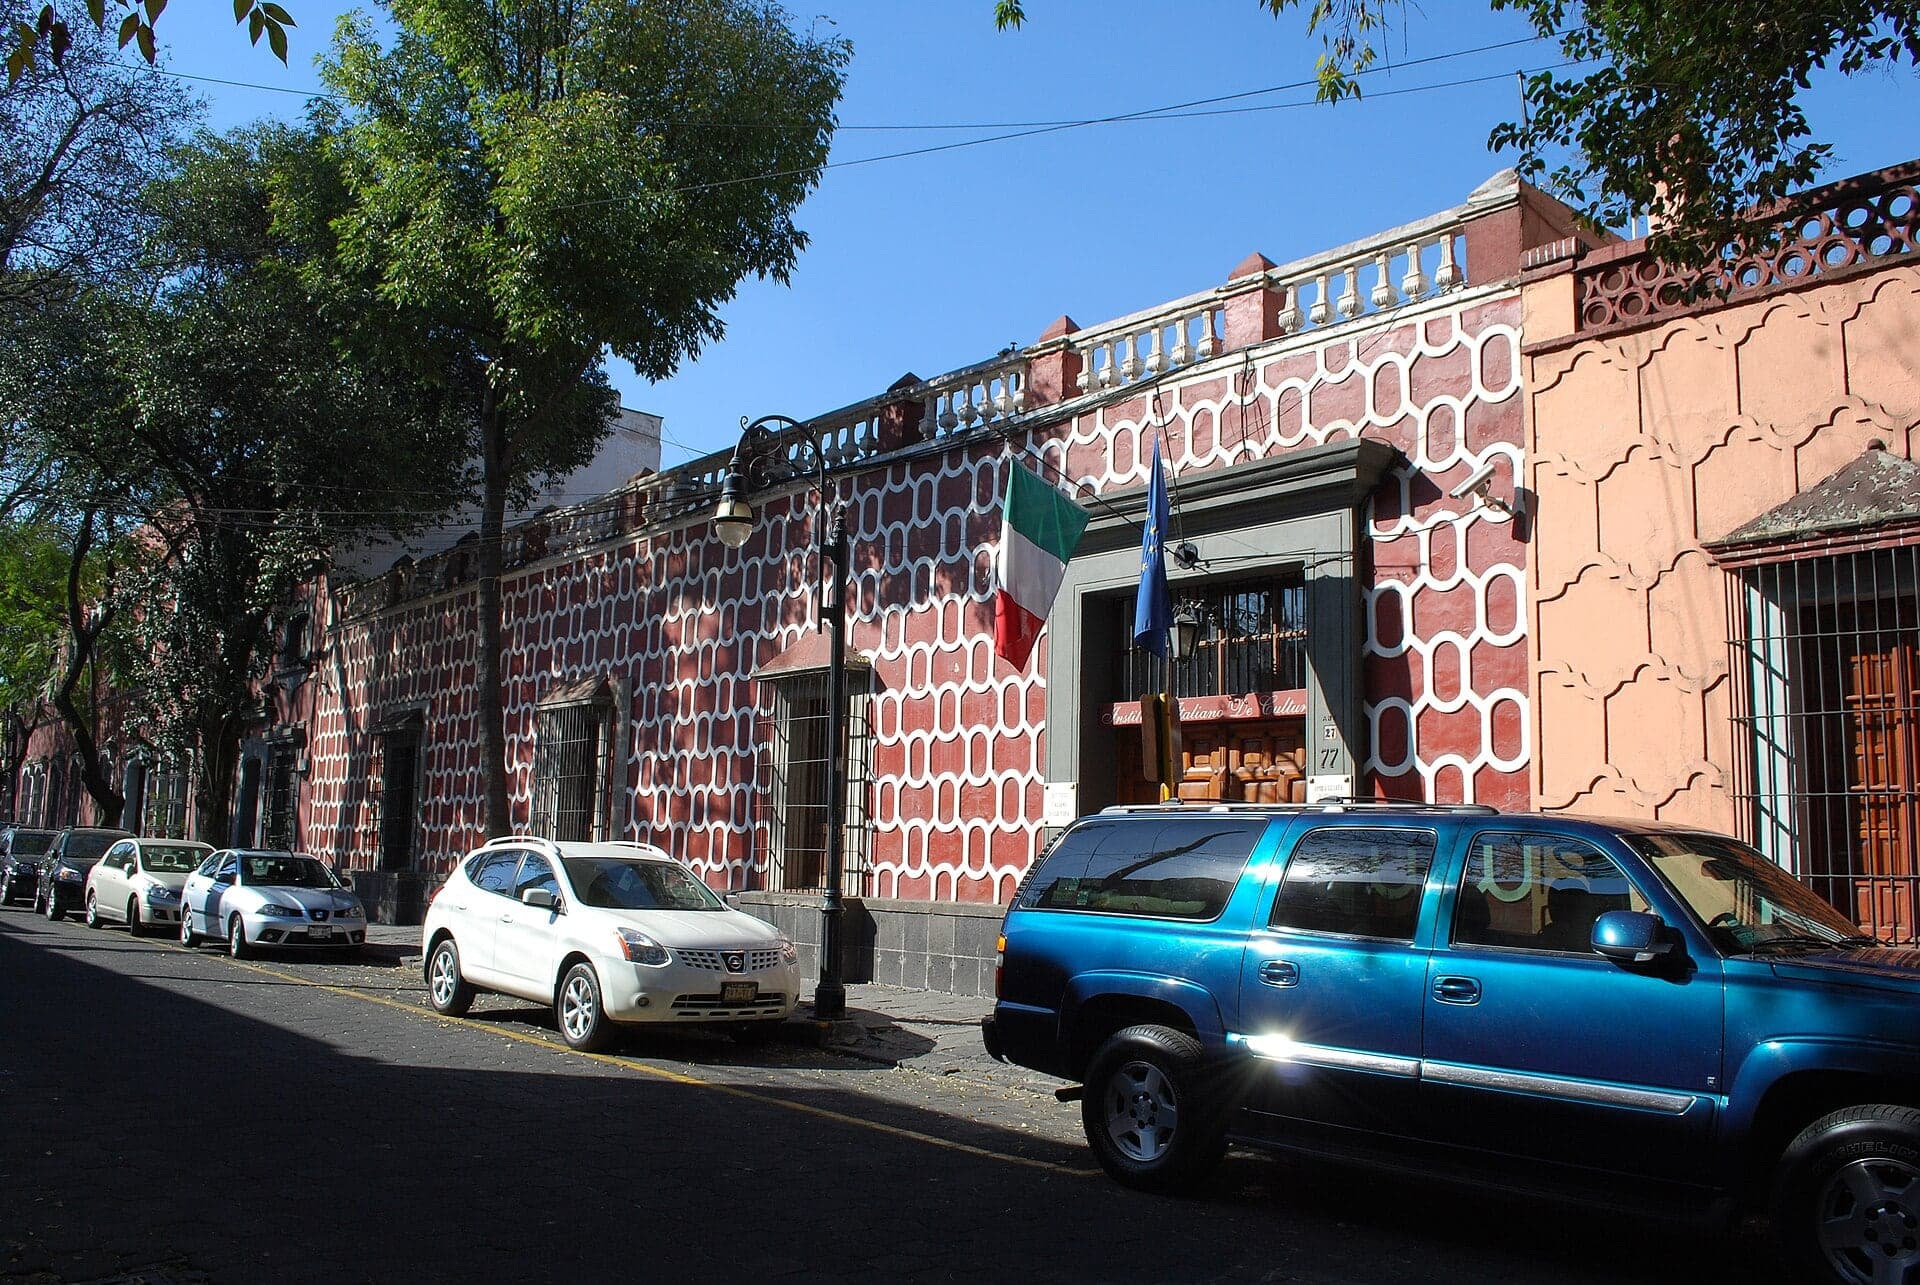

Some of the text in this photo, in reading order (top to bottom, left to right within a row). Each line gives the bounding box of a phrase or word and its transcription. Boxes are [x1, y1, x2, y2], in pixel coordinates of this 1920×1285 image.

[1101, 706, 1143, 724] Instit
[1229, 697, 1253, 717] De
[1259, 694, 1307, 714] Cultur
[1325, 728, 1335, 738] 27
[1320, 748, 1339, 768] 77
